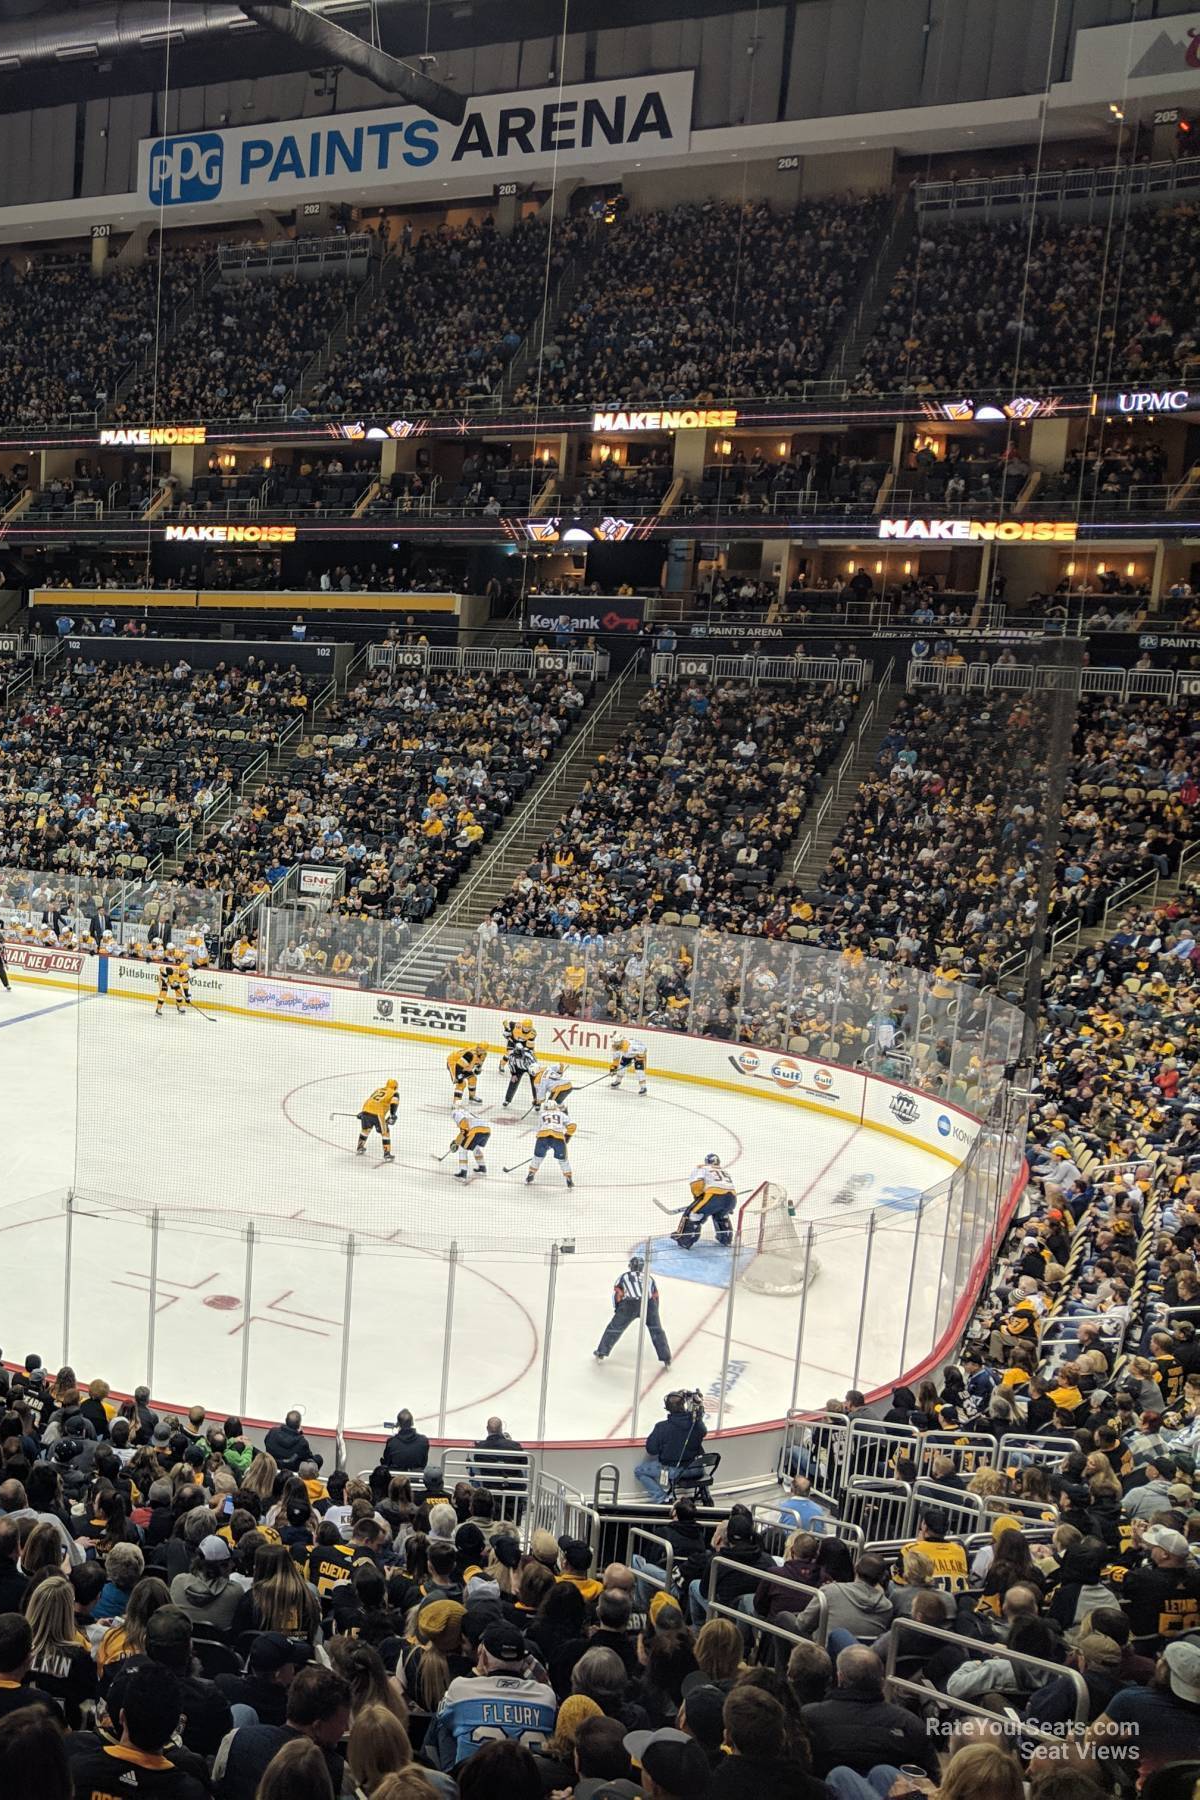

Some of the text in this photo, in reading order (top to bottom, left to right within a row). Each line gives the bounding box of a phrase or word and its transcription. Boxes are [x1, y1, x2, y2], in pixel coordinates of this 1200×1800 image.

[1153, 110, 1178, 124] 205
[151, 91, 673, 200] PPG PAINTS ARENA
[778, 157, 798, 170] 204
[499, 184, 517, 196] 203
[304, 203, 320, 215] 202
[92, 225, 111, 238] 201
[1118, 391, 1188, 412] UPMC
[530, 613, 600, 632] Keyank
[708, 626, 746, 637] PAINTS
[747, 627, 783, 637] ARENA
[68, 641, 81, 650] 102
[316, 647, 331, 657] 102
[398, 653, 423, 666] 103
[538, 656, 564, 670] 103
[680, 661, 708, 675] 104
[1181, 679, 1200, 695] 10
[118, 965, 223, 990] Pittsburg Gazette
[401, 1005, 467, 1022] RAM
[401, 1016, 466, 1032] 1500
[551, 1023, 610, 1050] xfini
[739, 1055, 760, 1067] Gulf
[773, 1066, 802, 1083] Gulf
[814, 1072, 833, 1086] Gulf
[889, 1096, 919, 1119] NHL
[319, 1561, 351, 1581] GUENT
[30, 1652, 73, 1679] LKIN
[482, 1704, 541, 1727] FLEURY
